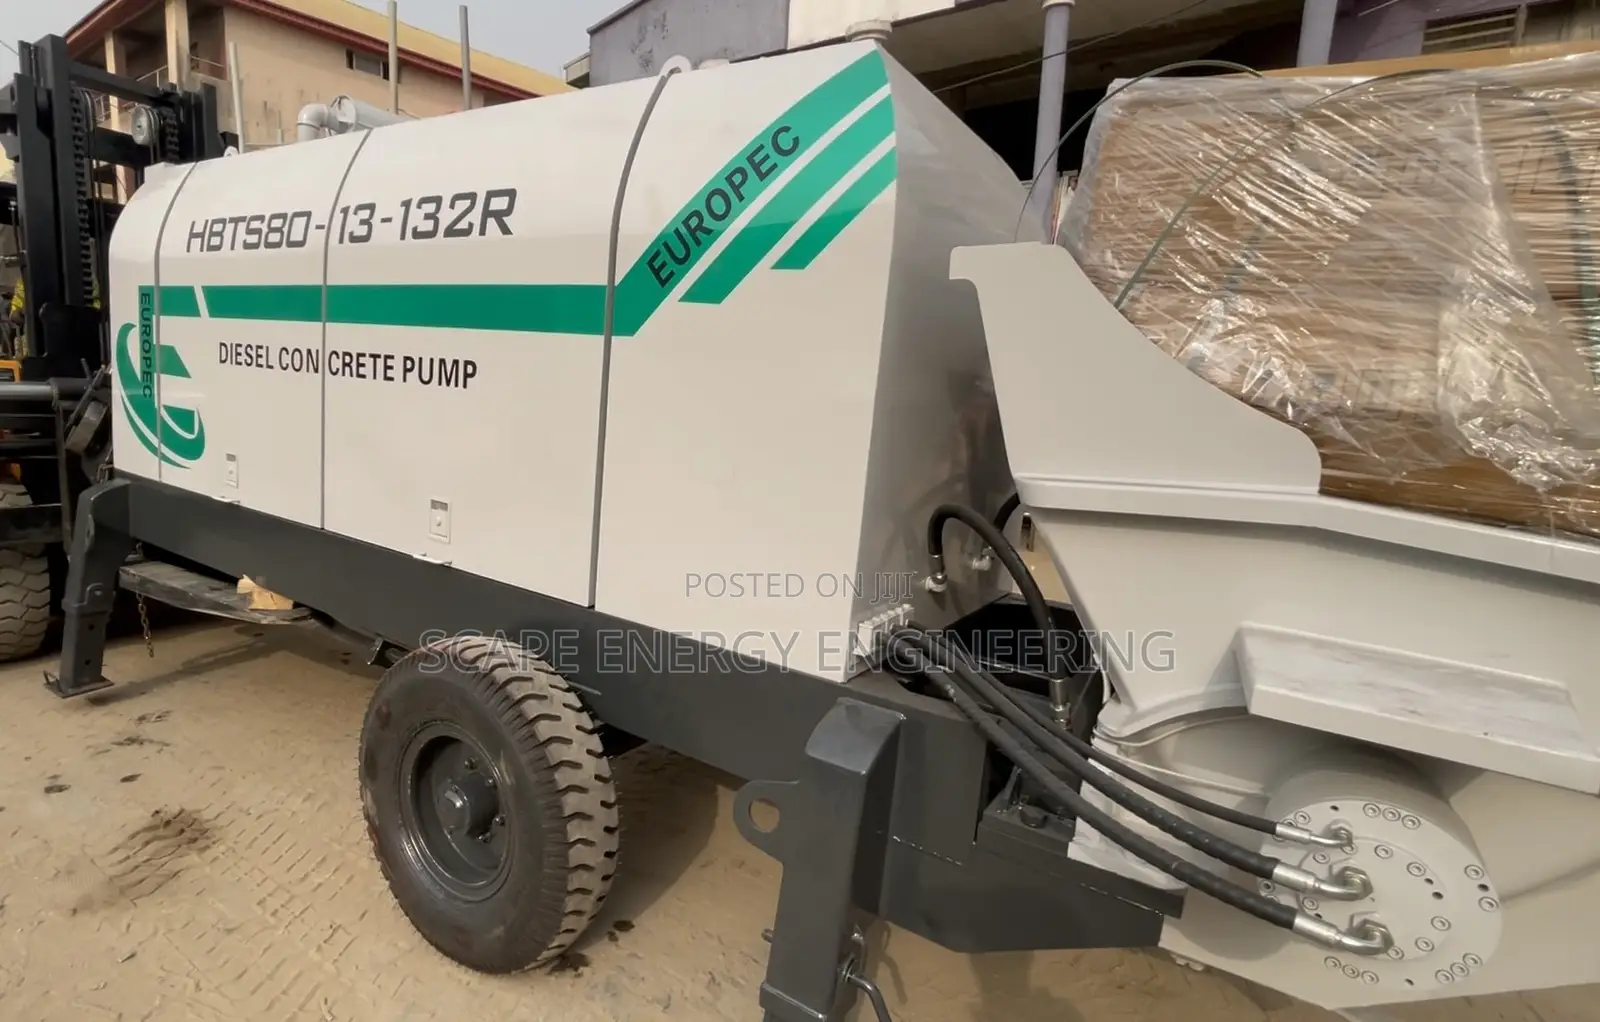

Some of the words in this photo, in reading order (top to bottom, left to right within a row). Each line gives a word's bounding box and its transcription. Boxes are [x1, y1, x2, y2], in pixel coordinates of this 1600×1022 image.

[646, 125, 801, 289] EUROPEC
[140, 293, 153, 399] EUROPEC
[219, 342, 274, 370] DIESEL
[402, 356, 478, 389] PUMP
